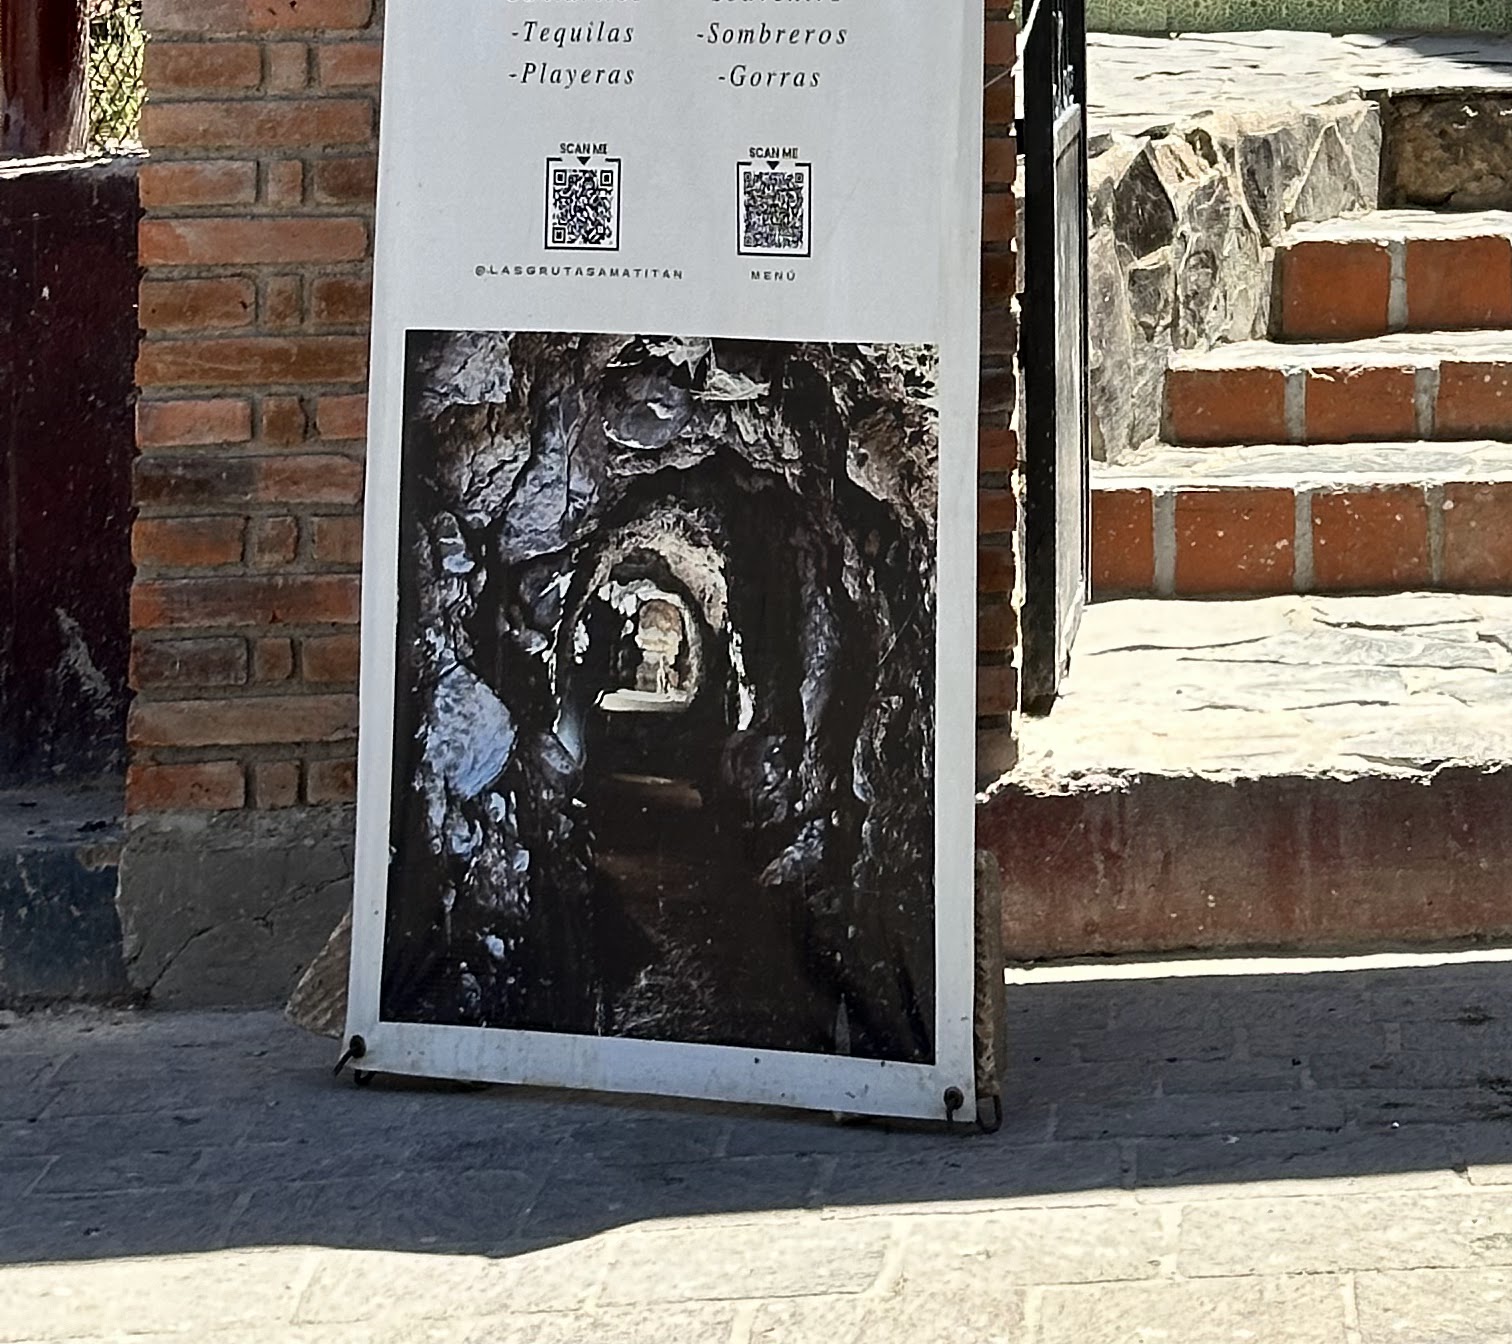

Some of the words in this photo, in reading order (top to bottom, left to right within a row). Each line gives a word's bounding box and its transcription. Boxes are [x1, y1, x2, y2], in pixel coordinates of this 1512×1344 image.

[512, 21, 633, 48] -Tequilas
[697, 23, 846, 44] -Sombreros
[509, 63, 633, 89] -Playeras
[719, 65, 819, 87] -Gorras
[560, 142, 590, 154] SCAN
[750, 147, 779, 158] SCAN
[750, 268, 796, 281] MENÚ
